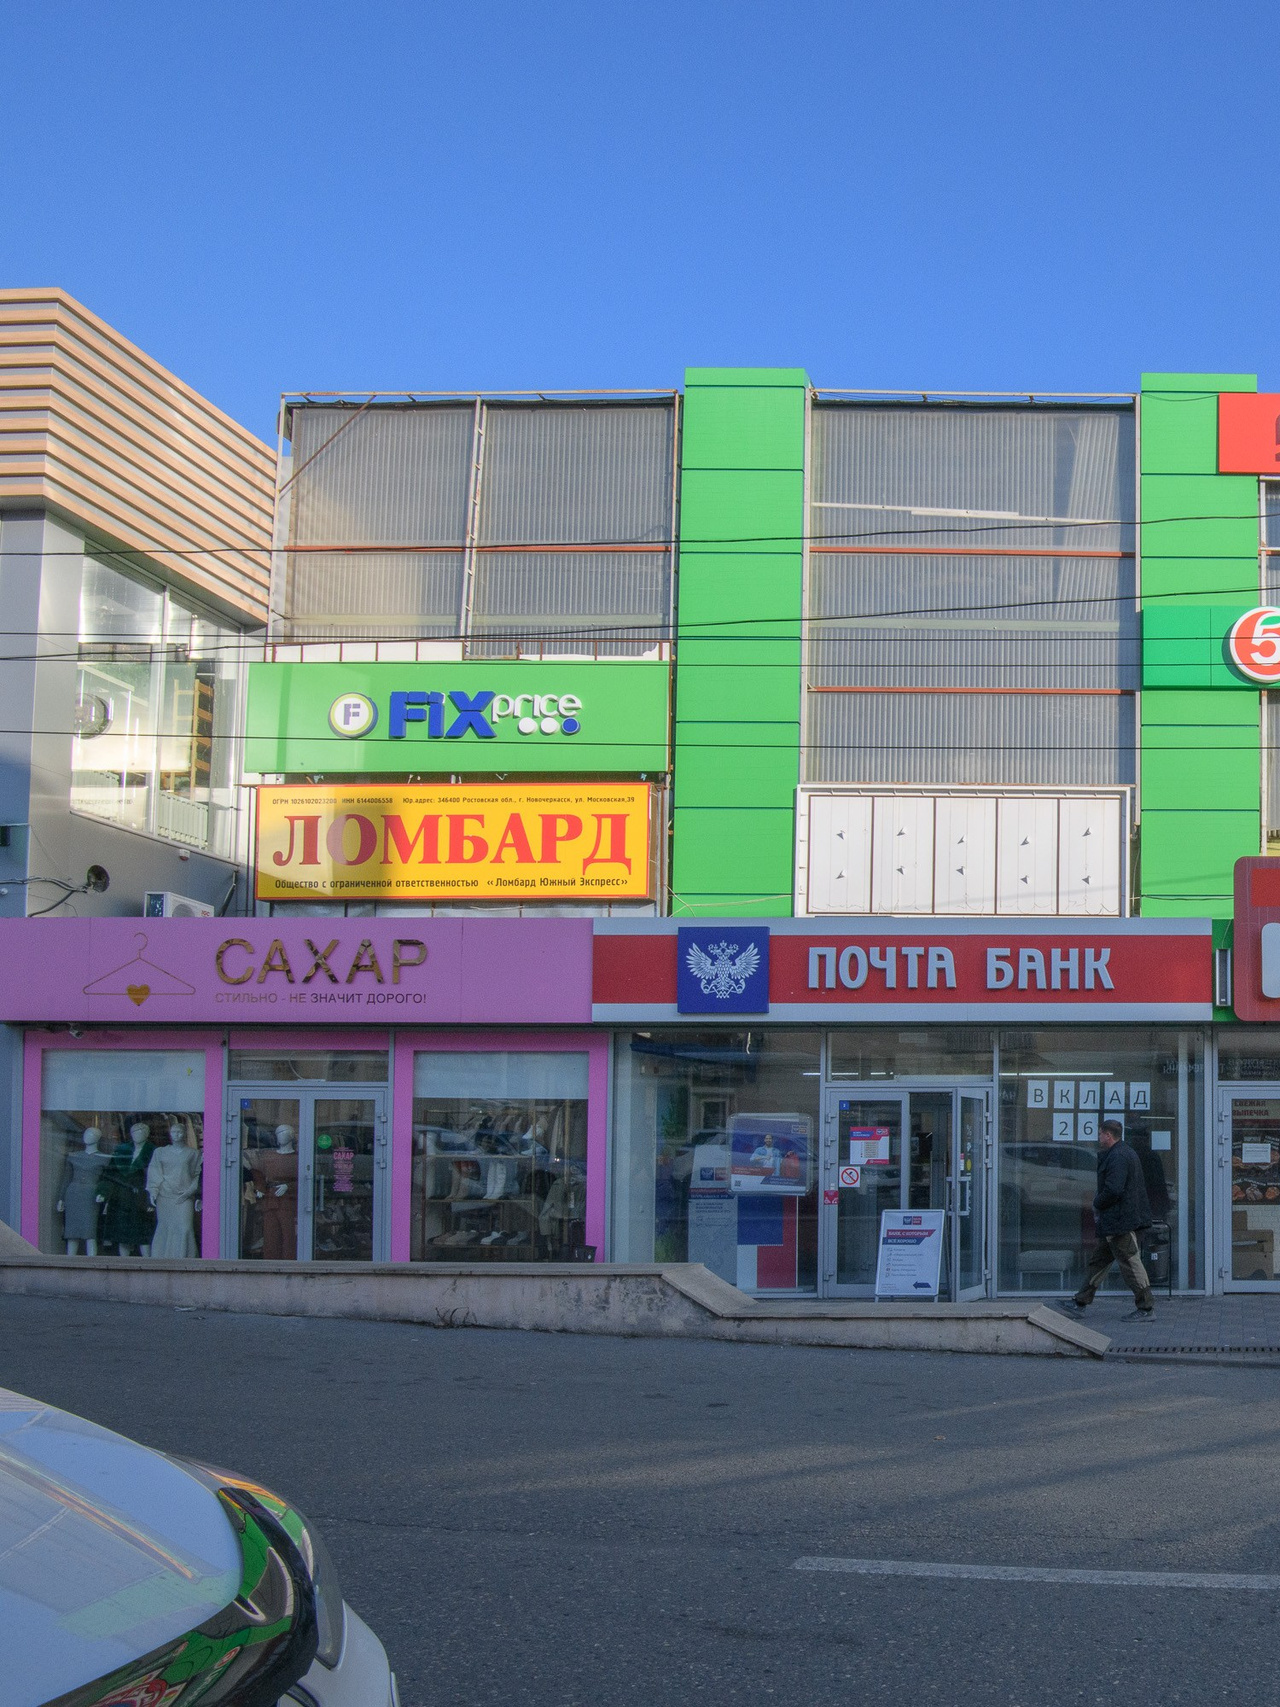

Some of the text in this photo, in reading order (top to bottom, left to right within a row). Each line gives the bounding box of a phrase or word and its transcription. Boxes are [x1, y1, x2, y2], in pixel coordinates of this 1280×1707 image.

[492, 693, 583, 724] price
[462, 796, 499, 804] Ростовская
[272, 813, 633, 876] ЛОМБАРД
[275, 879, 319, 890] Общество
[321, 881, 327, 889] с
[329, 878, 392, 889] ограниченной
[395, 879, 479, 889] ответственностью
[539, 877, 576, 888] Южный
[215, 937, 428, 985] САХАР
[807, 945, 1115, 990] ПОЧТА БАНК
[215, 993, 278, 1004] СТИЛЬНО
[289, 993, 307, 1004] НЕ
[310, 993, 363, 1004] ЗНАЧИТ
[366, 993, 427, 1005] ДОРОГО!
[1033, 1088, 1148, 1108] ВКЛАД
